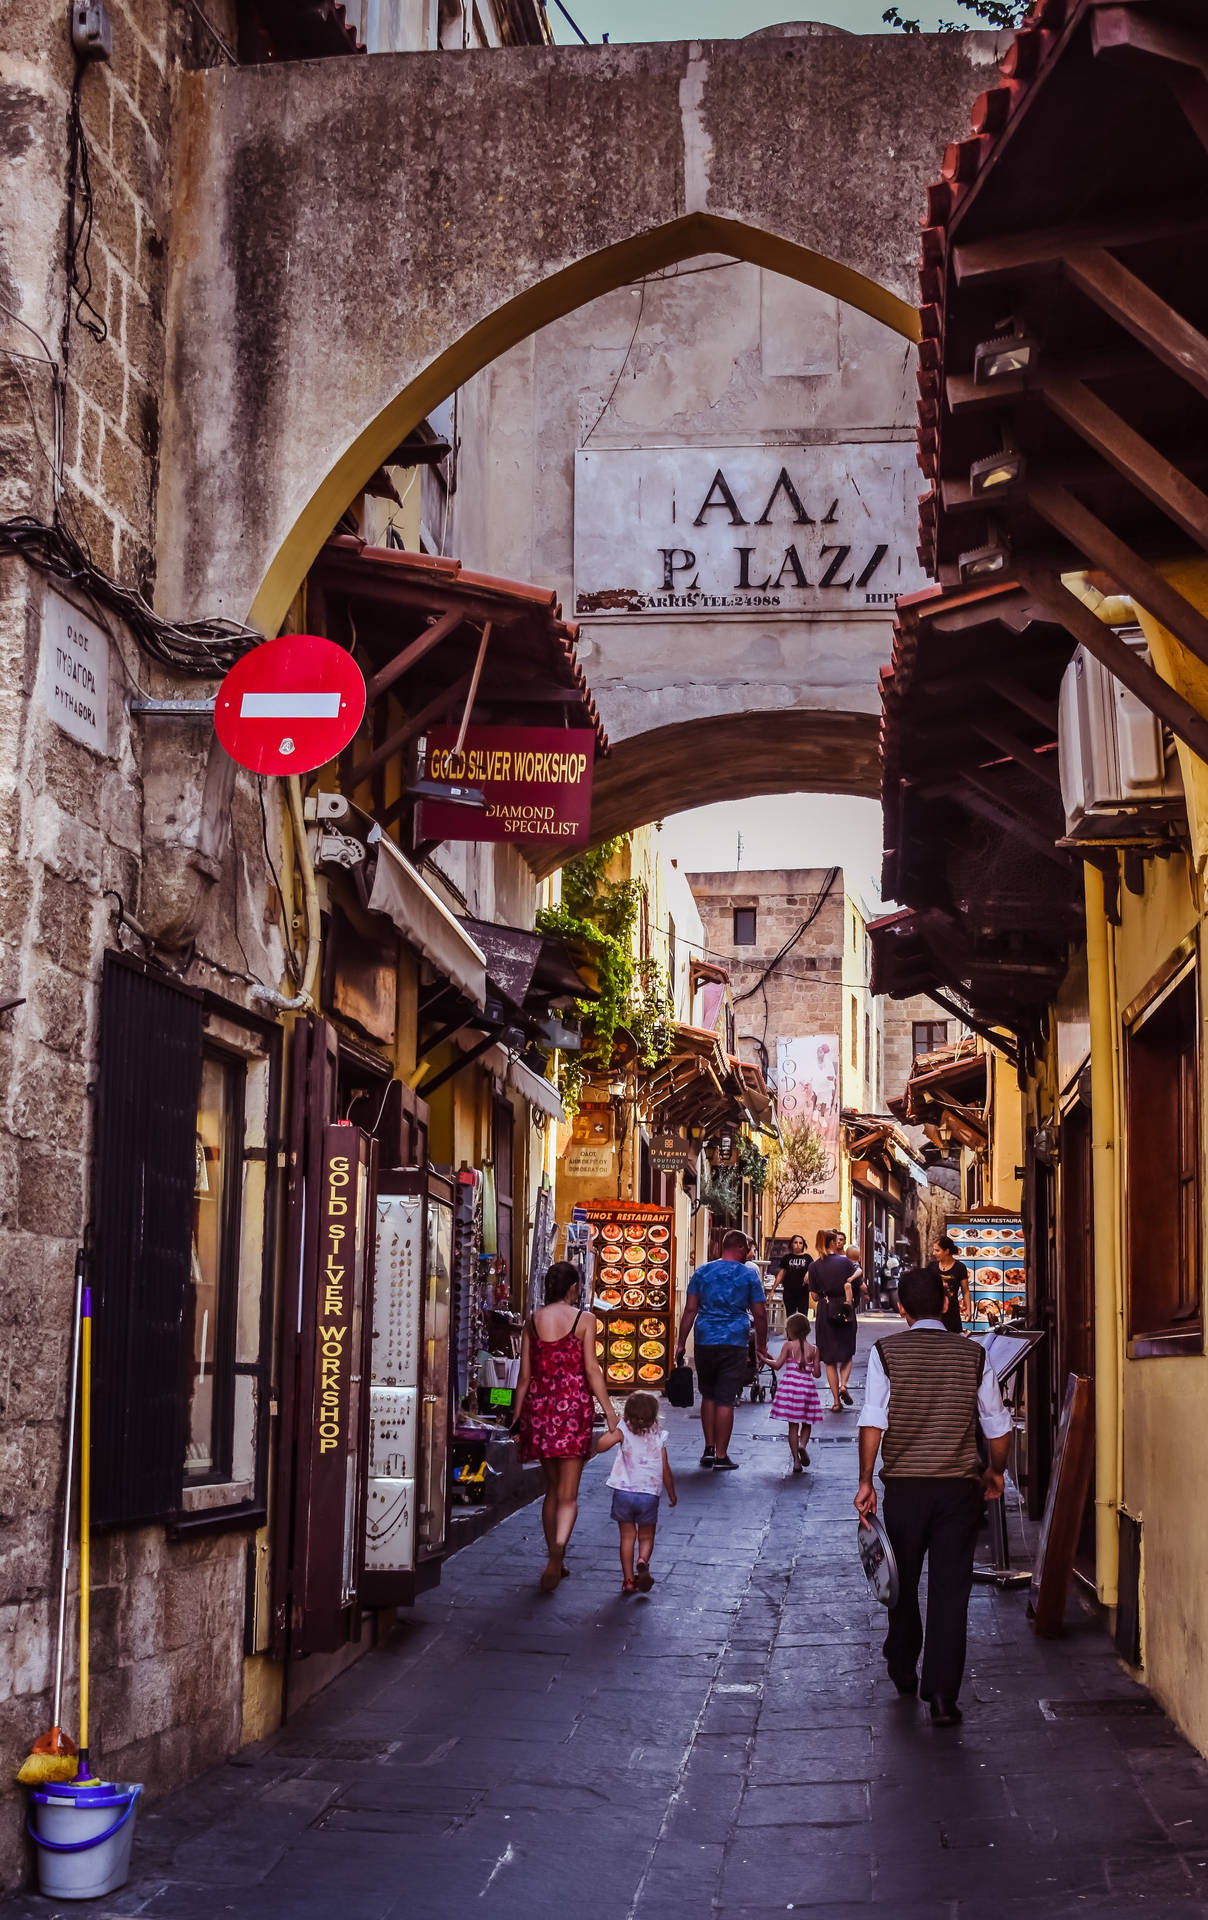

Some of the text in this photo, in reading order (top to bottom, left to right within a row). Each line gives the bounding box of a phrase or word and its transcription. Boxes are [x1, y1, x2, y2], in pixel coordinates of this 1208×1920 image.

[67, 625, 89, 652] ΟΔΟΣ
[56, 647, 96, 695] ΠΥΘΑΓΟΡΑ
[54, 685, 96, 728] PYTHAGORA
[430, 749, 587, 784] GOLD SILVER WORKSHOP
[486, 805, 554, 820] DIAMOND
[504, 820, 579, 835] SPECIALIST
[616, 1212, 670, 1222] RESTAURANT
[319, 1156, 350, 1455] GOLD SILVER WORKSHOP
